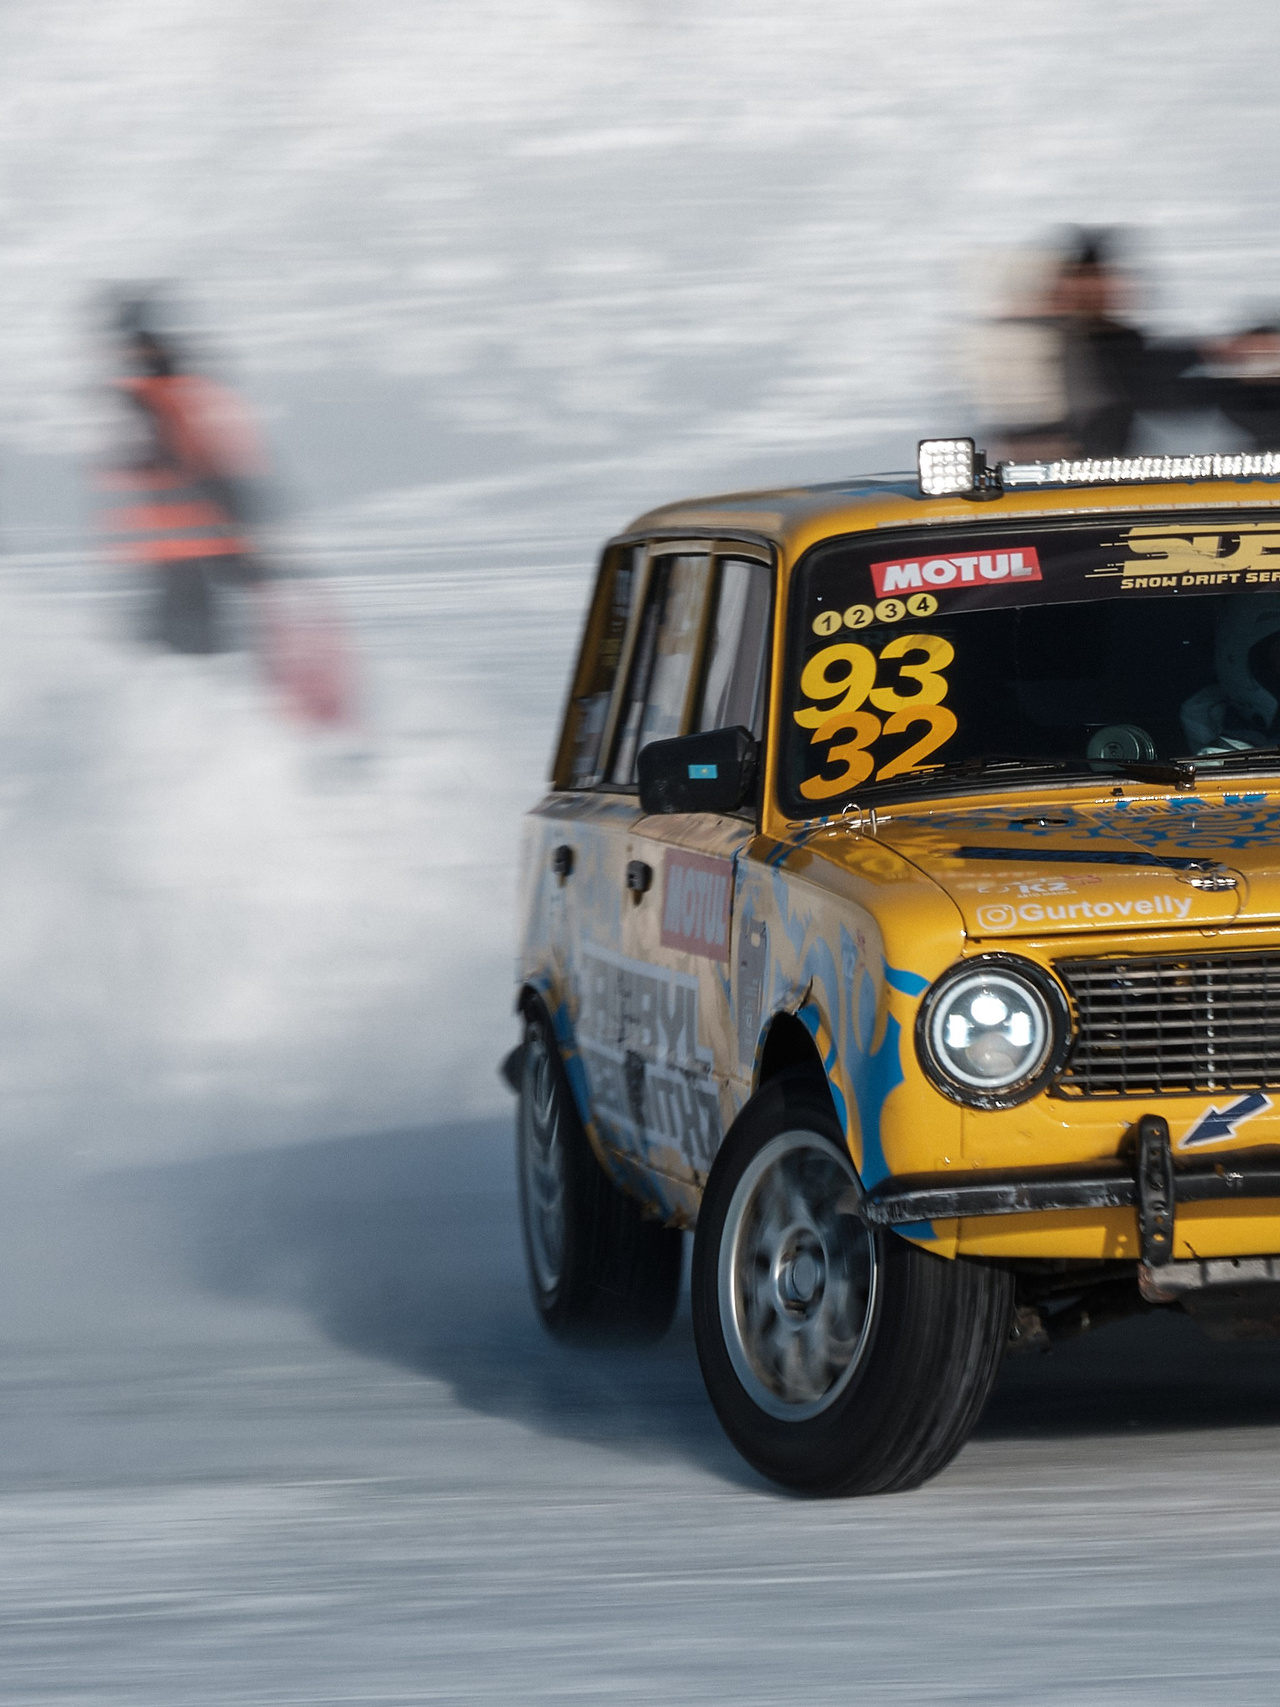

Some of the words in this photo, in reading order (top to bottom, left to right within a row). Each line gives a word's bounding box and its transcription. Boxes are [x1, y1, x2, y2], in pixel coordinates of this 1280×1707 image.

[882, 552, 1033, 592] MOTUL
[1120, 576, 1178, 590] SNOW
[1181, 572, 1241, 586] DRIFT
[793, 633, 956, 729] 93
[799, 704, 958, 800] 32
[664, 864, 727, 946] MOTUL
[1018, 895, 1193, 922] Gurtovelly
